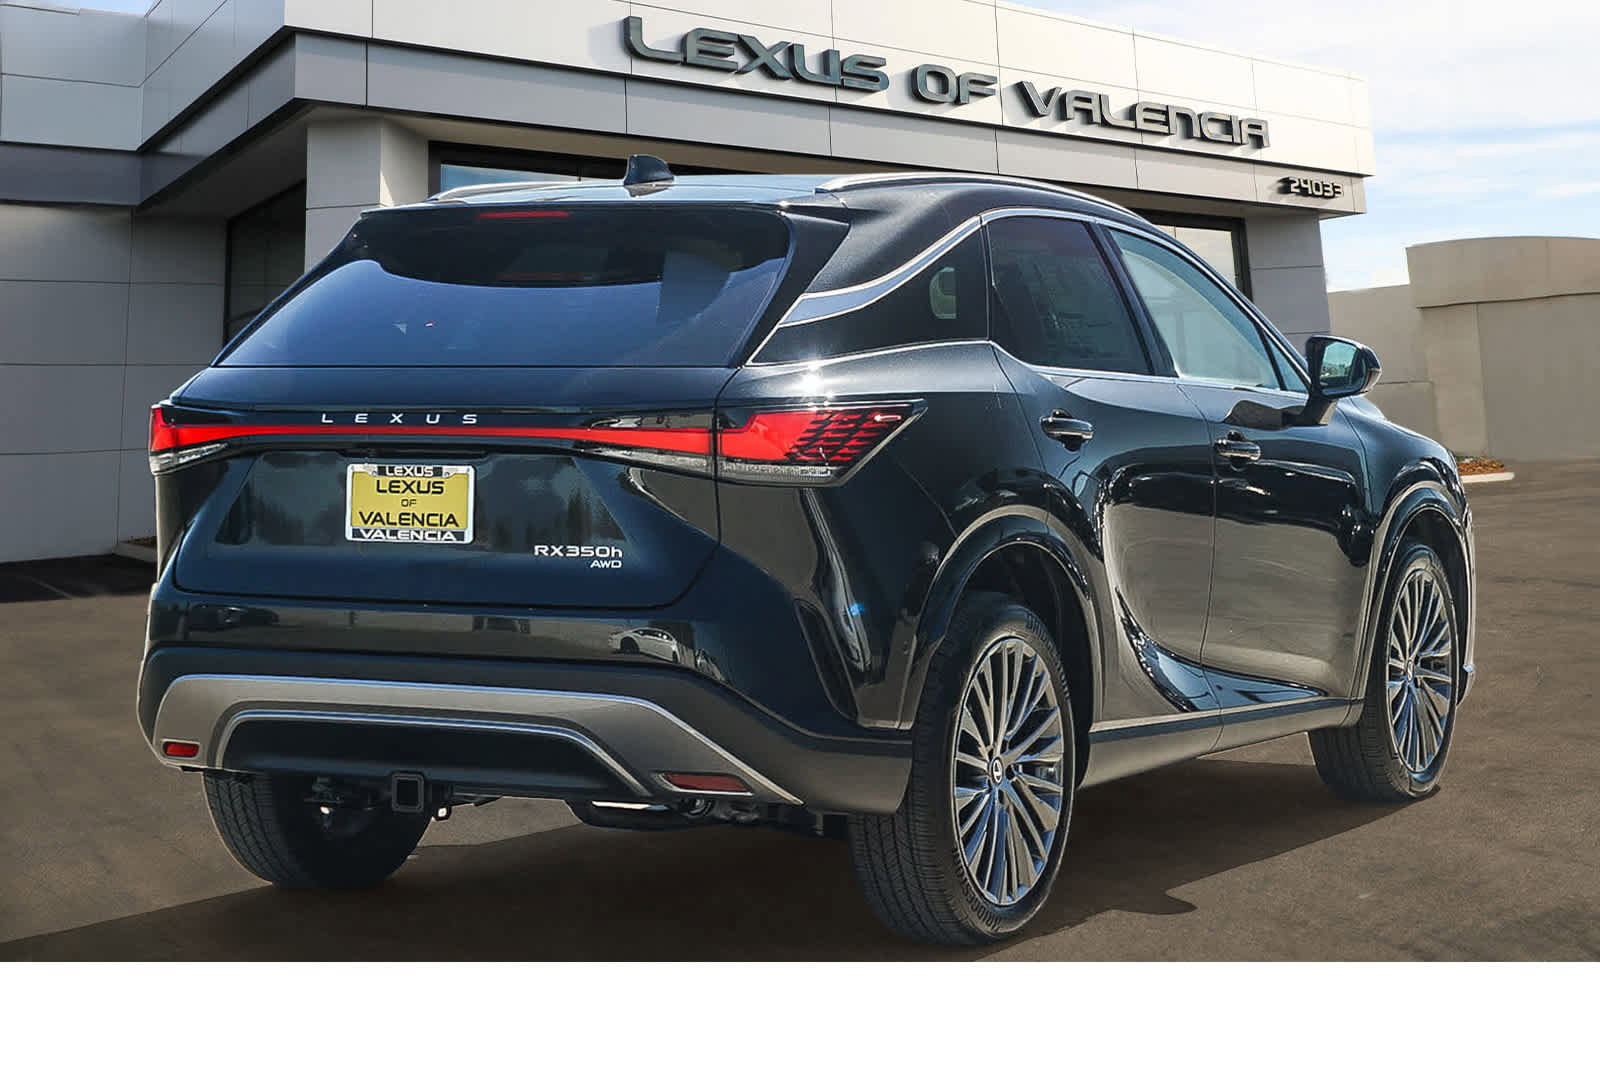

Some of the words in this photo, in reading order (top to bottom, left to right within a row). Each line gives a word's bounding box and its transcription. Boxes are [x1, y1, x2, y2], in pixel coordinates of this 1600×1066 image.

[623, 16, 889, 91] LEXUS
[911, 63, 998, 105] OF
[1015, 80, 1271, 148] VALENCIA
[1283, 177, 1344, 199] 24033
[321, 412, 478, 425] LEXUS
[385, 465, 434, 477] LEXUS
[375, 479, 445, 495] LEXUS
[400, 498, 417, 508] OF
[358, 511, 460, 528] VALENCIA
[359, 529, 457, 541] VALENCIA
[533, 544, 623, 558] RX350h
[589, 559, 623, 569] AWD
